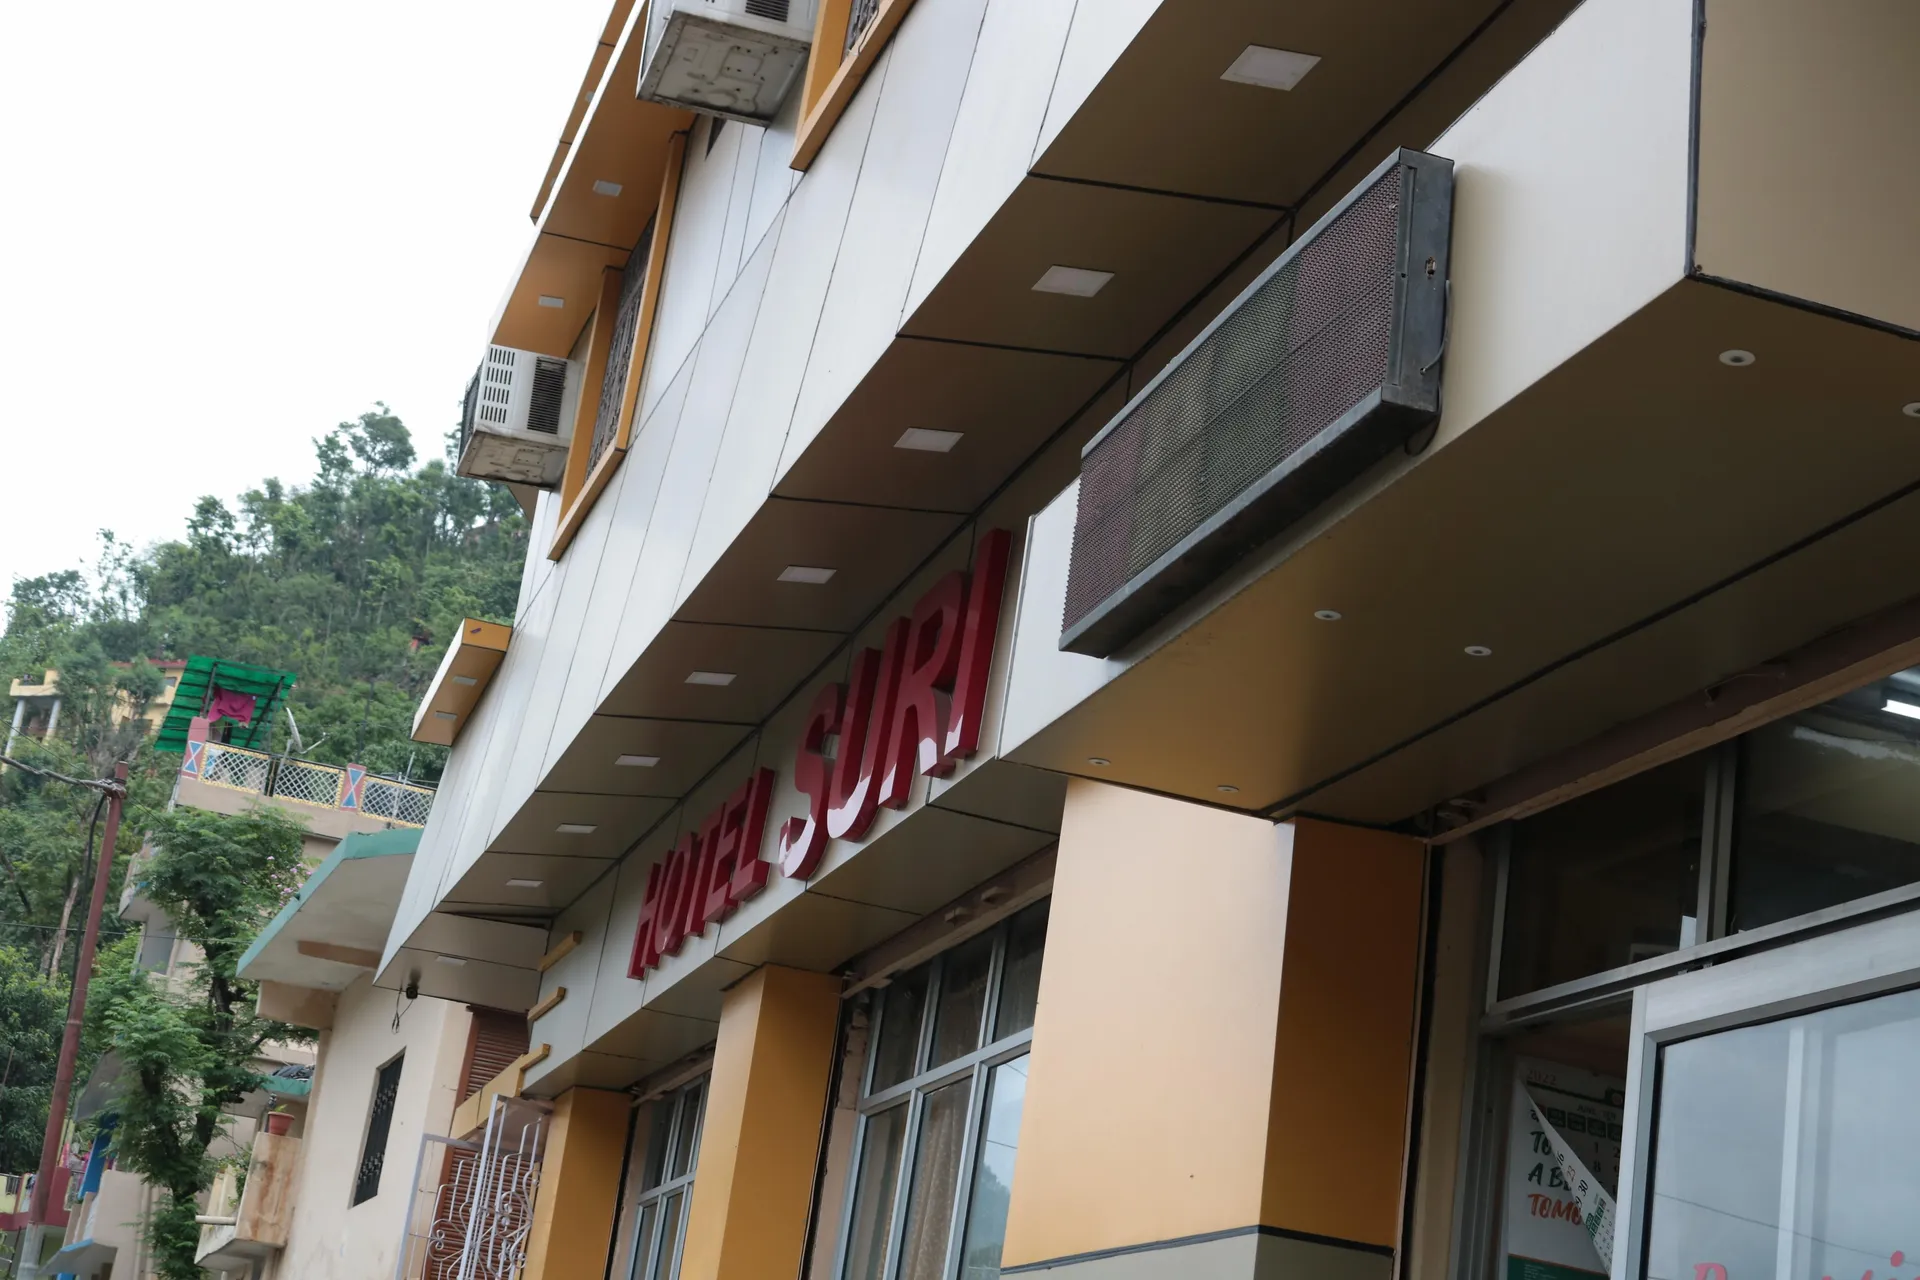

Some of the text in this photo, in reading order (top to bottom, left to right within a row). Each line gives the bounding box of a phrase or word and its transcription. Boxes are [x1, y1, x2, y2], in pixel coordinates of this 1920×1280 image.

[626, 527, 1012, 980] HOTEL SURI
[1527, 1068, 1557, 1086] 2022
[1528, 1162, 1544, 1187] A
[1577, 1179, 1589, 1197] 30
